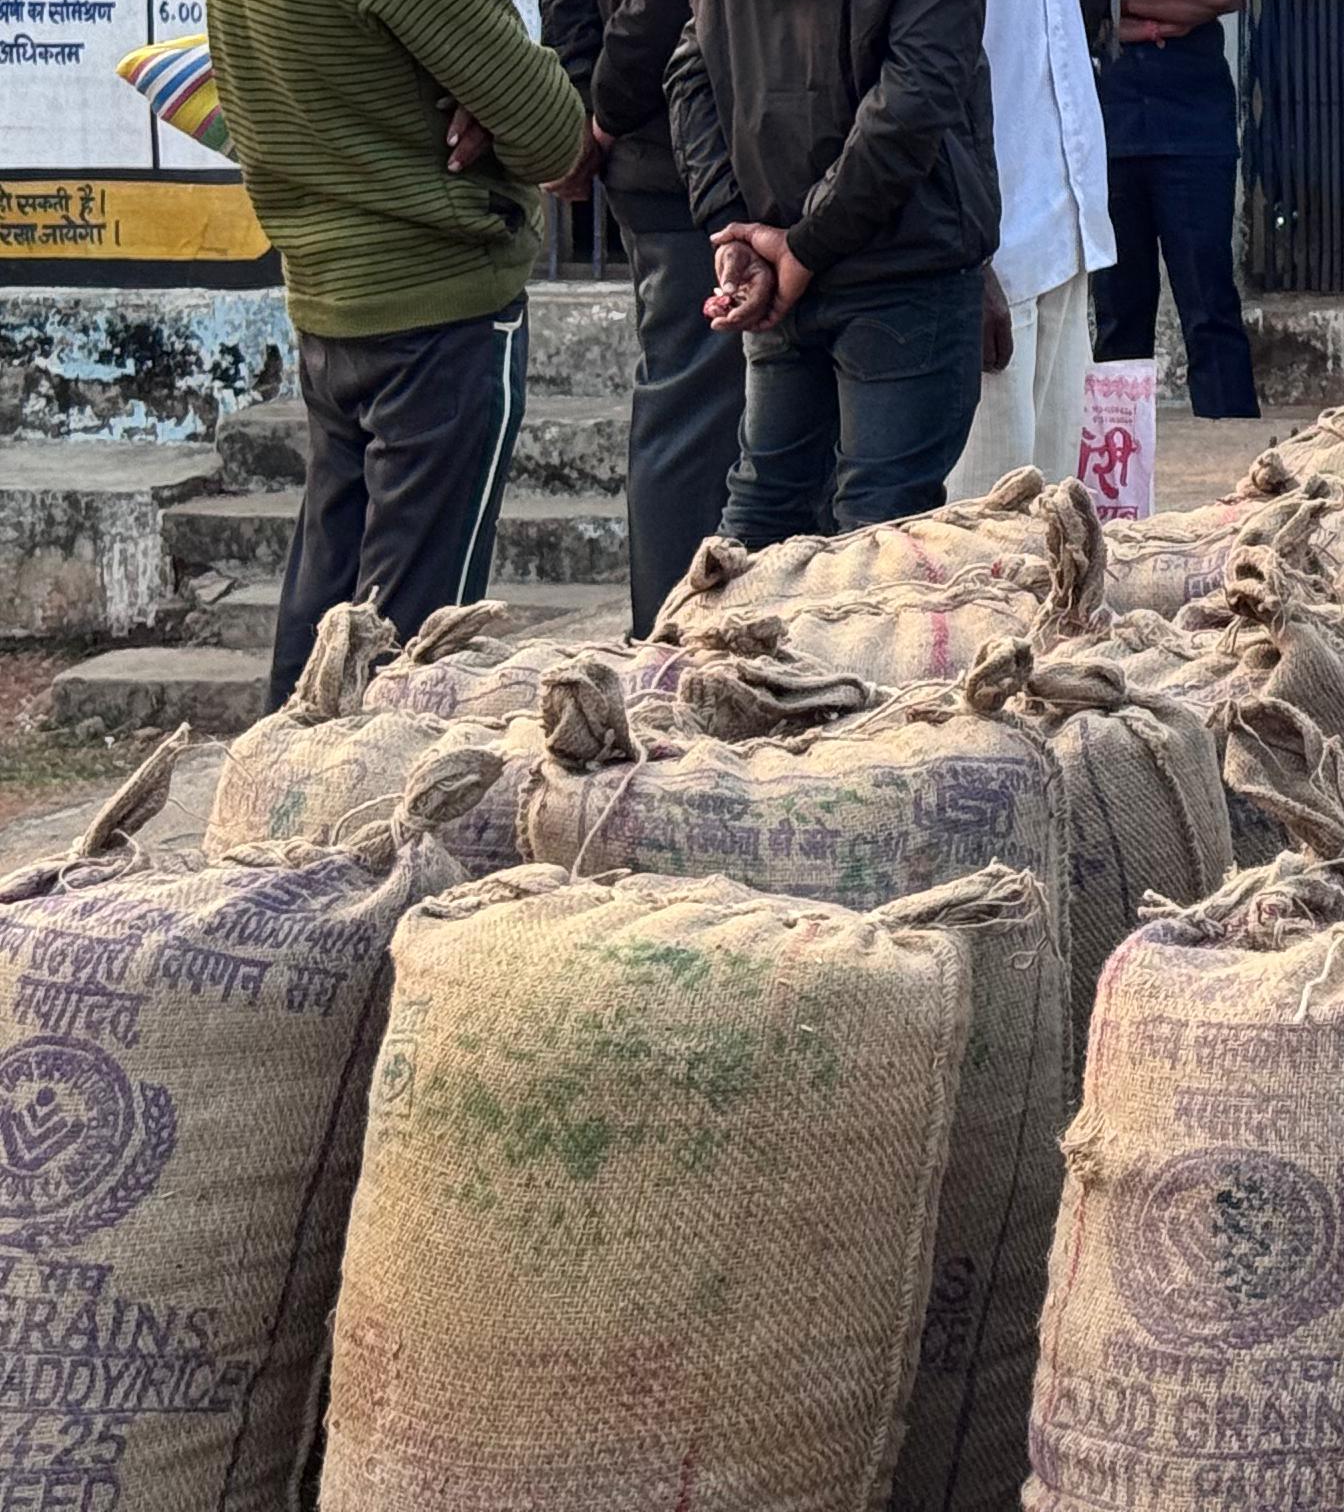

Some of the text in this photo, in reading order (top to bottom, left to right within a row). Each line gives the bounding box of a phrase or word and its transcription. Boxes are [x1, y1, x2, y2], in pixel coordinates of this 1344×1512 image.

[28, 2, 45, 23] का
[159, 1, 203, 24] 6.00
[16, 191, 71, 217] सकती
